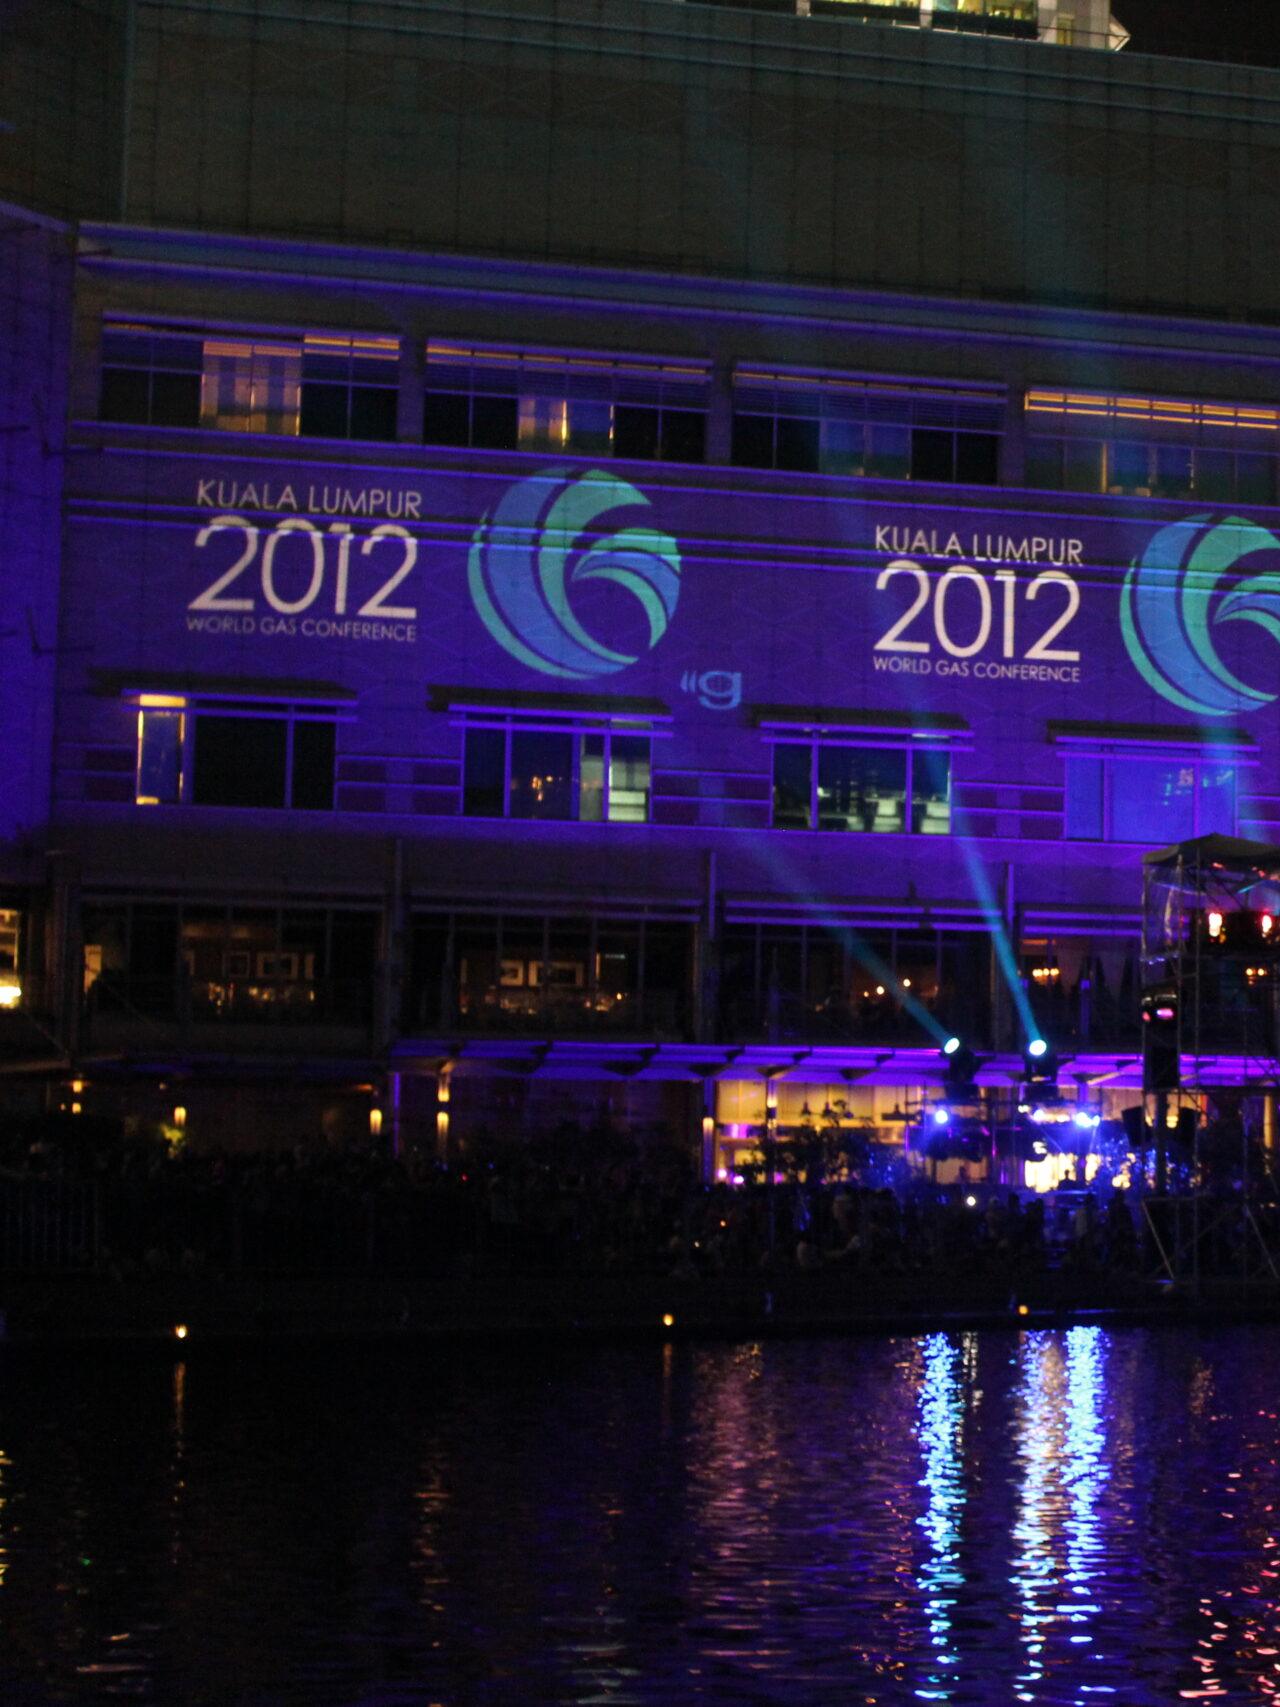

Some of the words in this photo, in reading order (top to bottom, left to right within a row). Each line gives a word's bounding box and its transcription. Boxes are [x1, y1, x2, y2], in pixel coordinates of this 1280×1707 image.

[197, 479, 298, 512] KUALA
[308, 487, 422, 518] LUMPUR
[875, 525, 962, 560] KUALA
[972, 533, 1083, 566] LUMPUR
[187, 515, 417, 619] 2012
[185, 615, 255, 635] WORLD
[260, 618, 297, 637] GAS
[301, 619, 417, 642] CONFERENCE
[873, 560, 1080, 661] 2012
[873, 656, 931, 675] WORLD
[935, 659, 970, 677] GAS
[973, 661, 1080, 683] CONFERENCE
